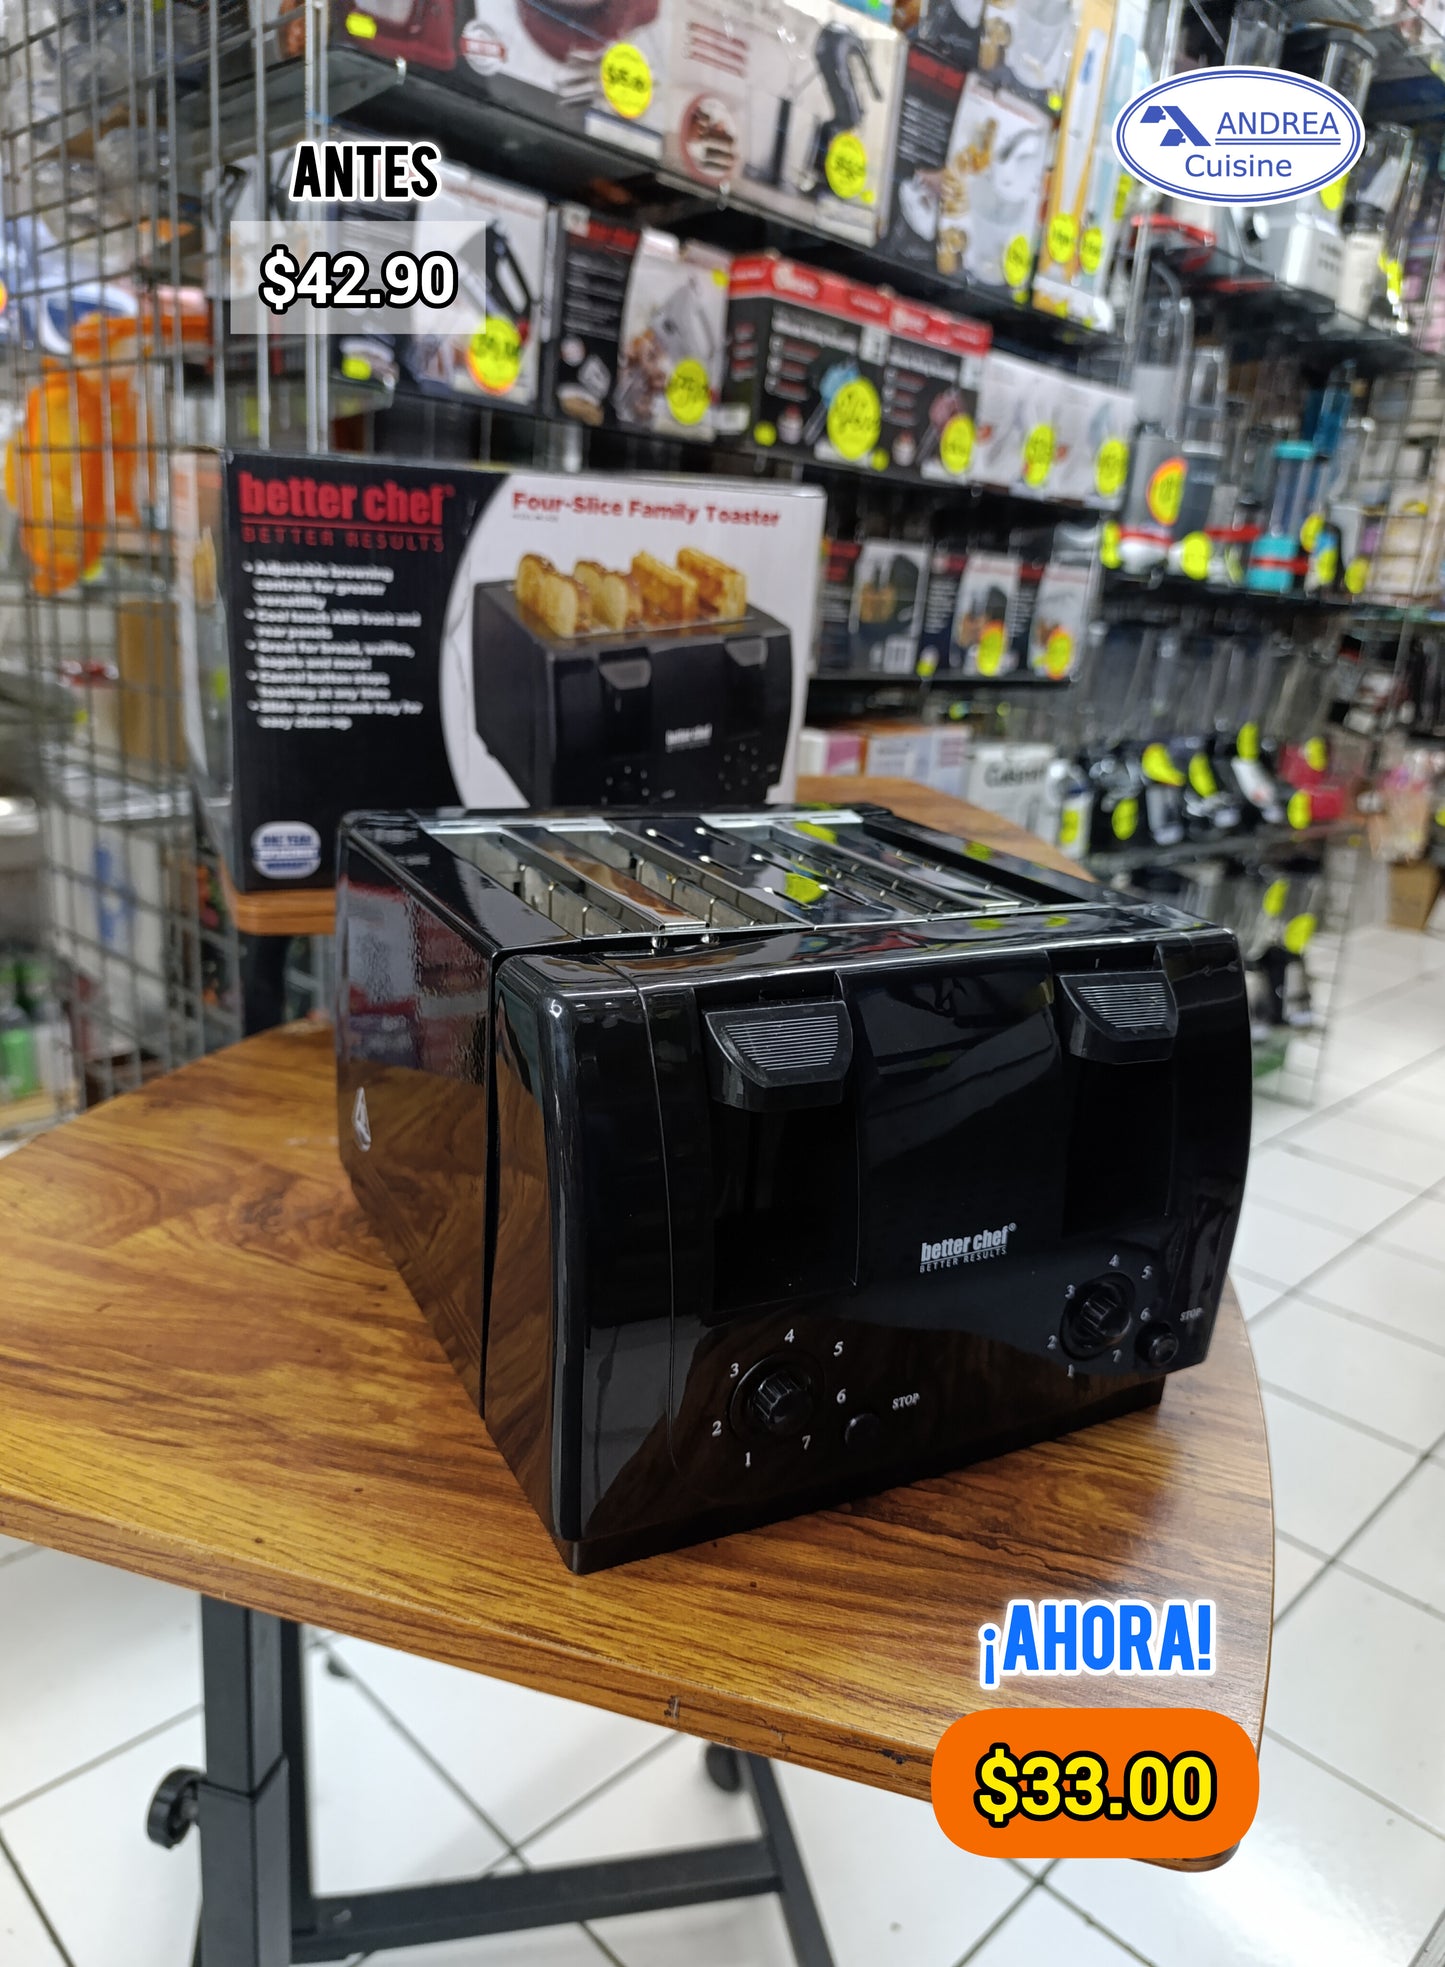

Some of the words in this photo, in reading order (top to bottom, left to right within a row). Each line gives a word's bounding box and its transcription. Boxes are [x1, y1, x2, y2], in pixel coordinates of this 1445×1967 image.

[238, 471, 358, 520] better
[511, 491, 624, 517] Four-Slice
[628, 500, 699, 525] Family
[705, 505, 782, 528] Toaster
[241, 525, 334, 546] BETTER
[344, 531, 444, 553] RESULTS
[920, 1235, 972, 1262] better
[919, 1257, 959, 1274] BETTER
[962, 1246, 1008, 1263] RESULTS
[1108, 1253, 1121, 1268] 4
[1141, 1264, 1153, 1280] 5
[1064, 1283, 1077, 1299] 3
[1139, 1306, 1151, 1322] 6
[1179, 1306, 1204, 1323] STOP
[784, 1327, 796, 1343] 4
[1046, 1334, 1058, 1350] 2
[833, 1340, 844, 1357] 5
[1112, 1348, 1122, 1364] 7
[729, 1361, 740, 1379] 3
[1066, 1363, 1075, 1379] 1
[836, 1387, 847, 1404] 6
[891, 1391, 921, 1411] STOP
[711, 1419, 723, 1437] 2
[802, 1434, 812, 1450] 7
[744, 1451, 752, 1468] 1
